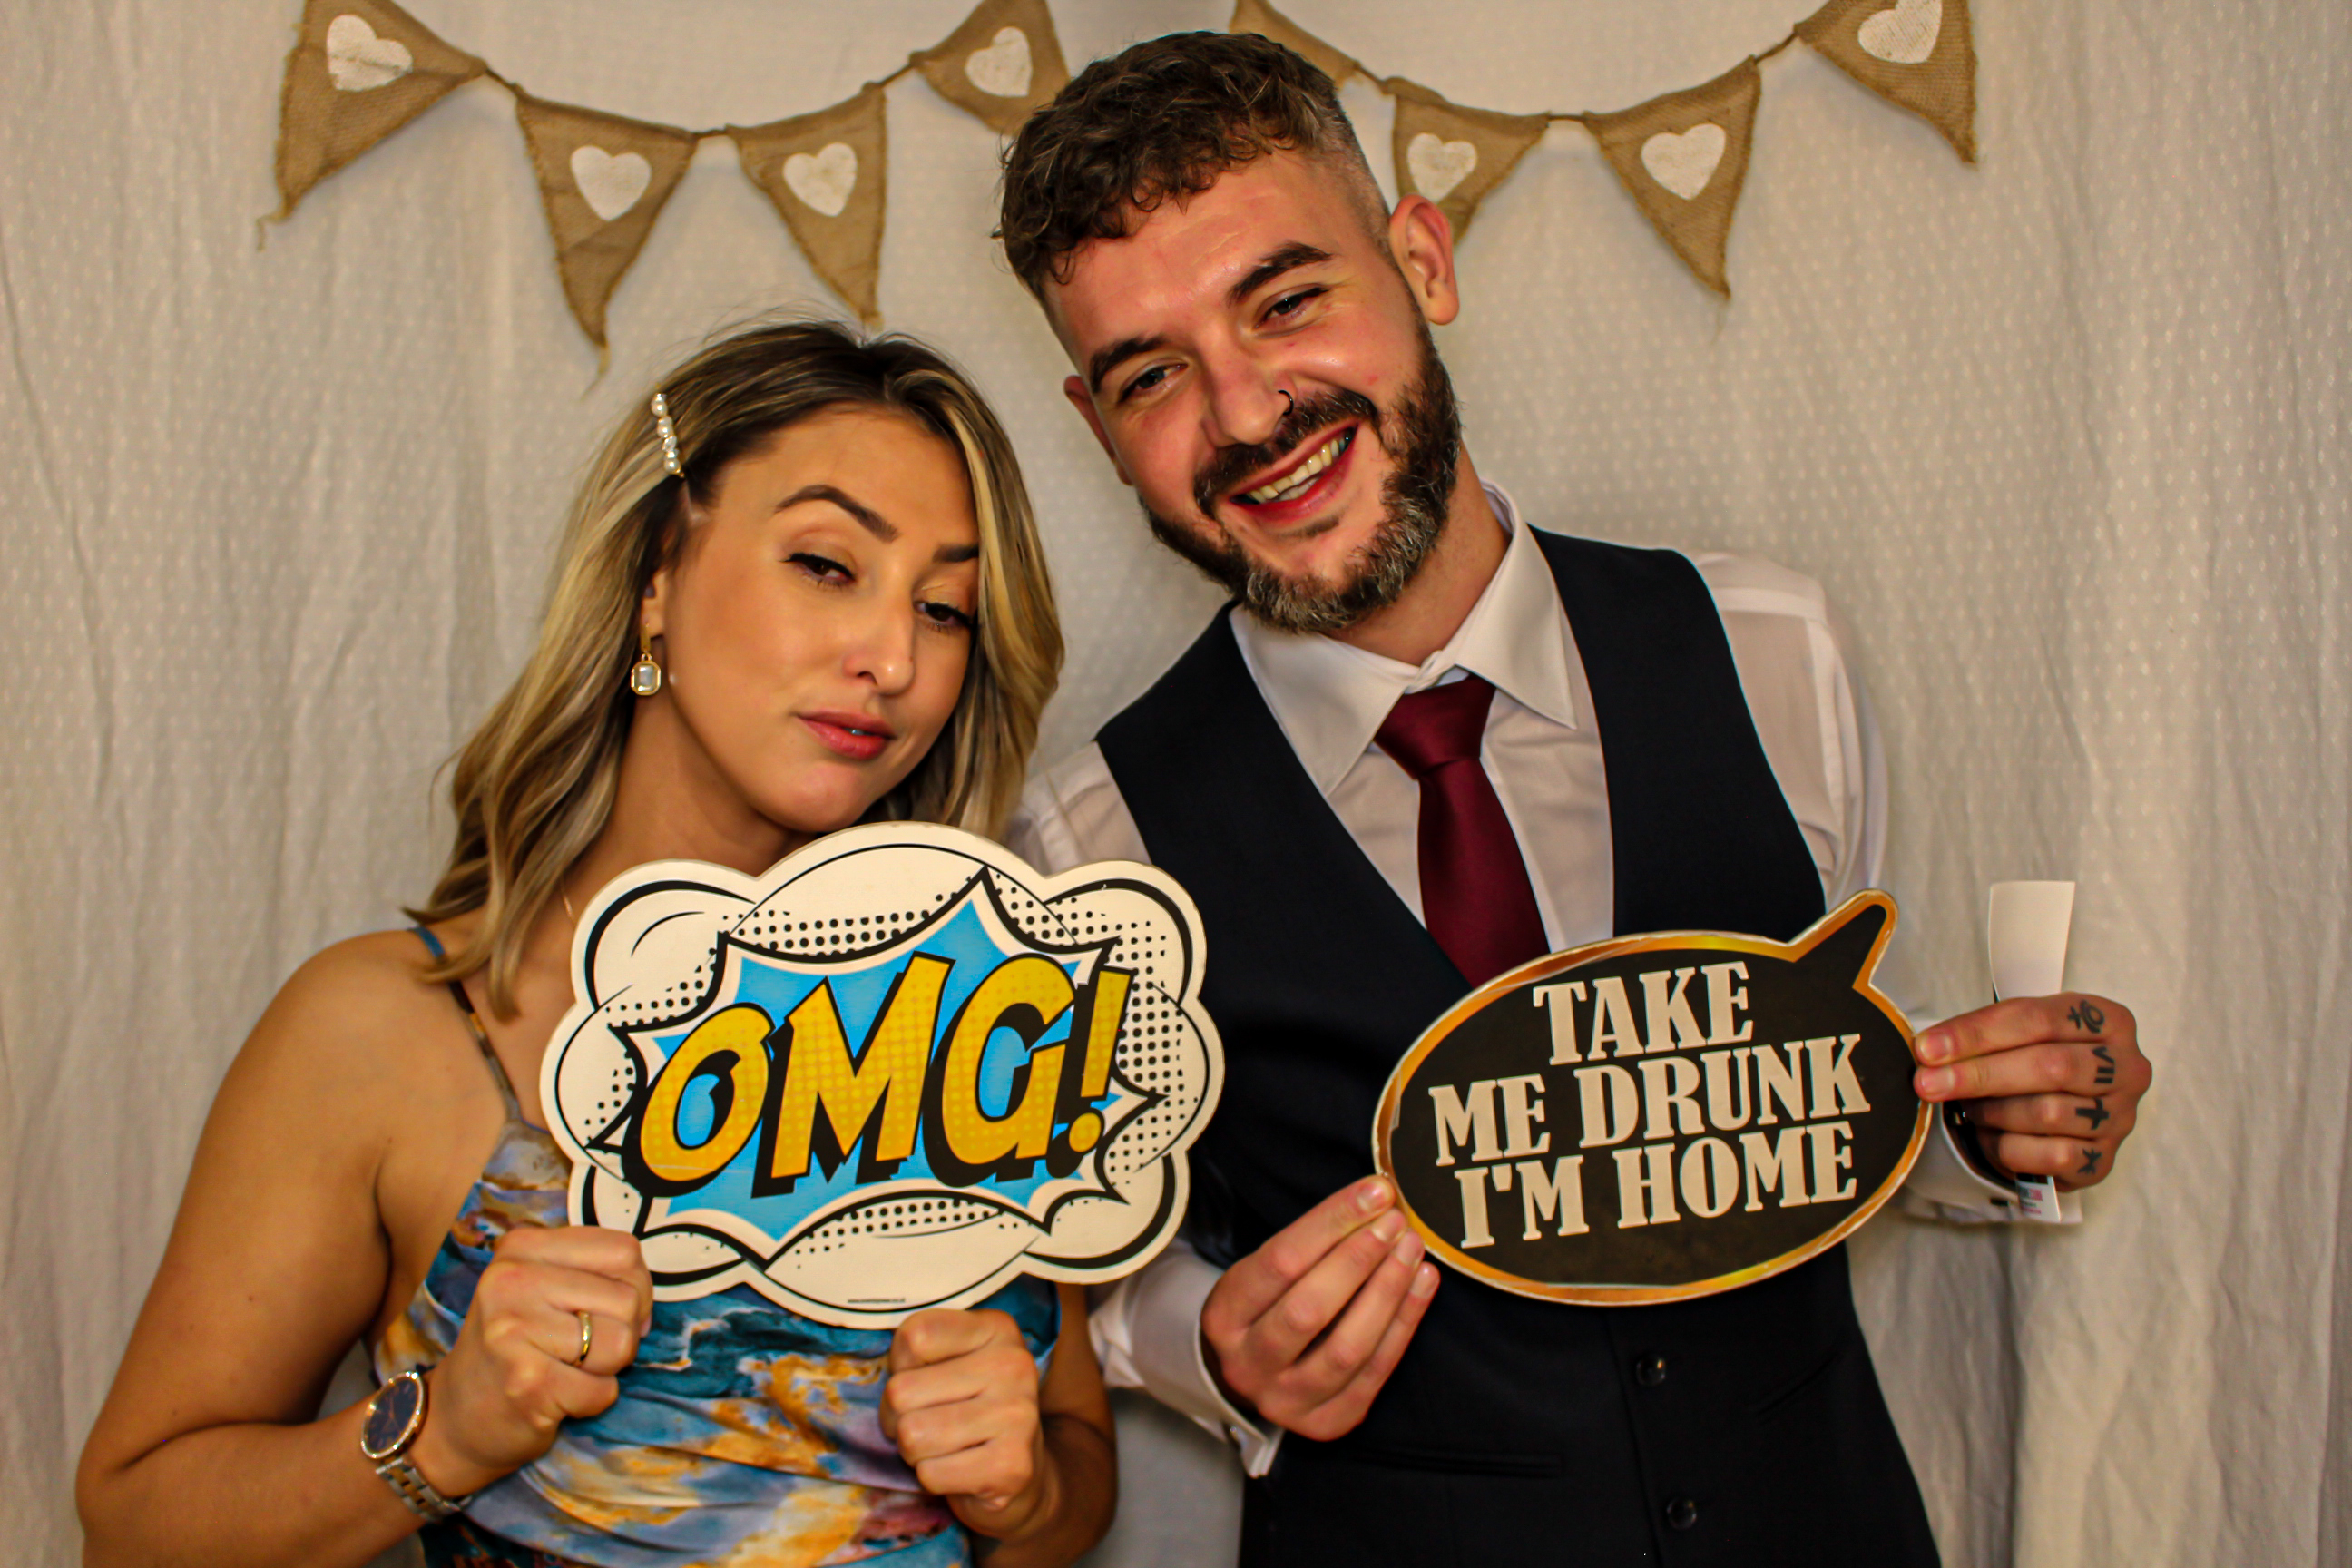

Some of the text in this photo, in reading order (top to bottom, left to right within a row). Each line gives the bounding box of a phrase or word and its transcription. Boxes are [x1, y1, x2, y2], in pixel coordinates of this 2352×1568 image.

[635, 951, 1134, 1191] OMG!
[1532, 960, 1753, 1065] TAKE
[1427, 1033, 1871, 1166] ME DRUNK
[1455, 1121, 1857, 1249] I'M HOME
